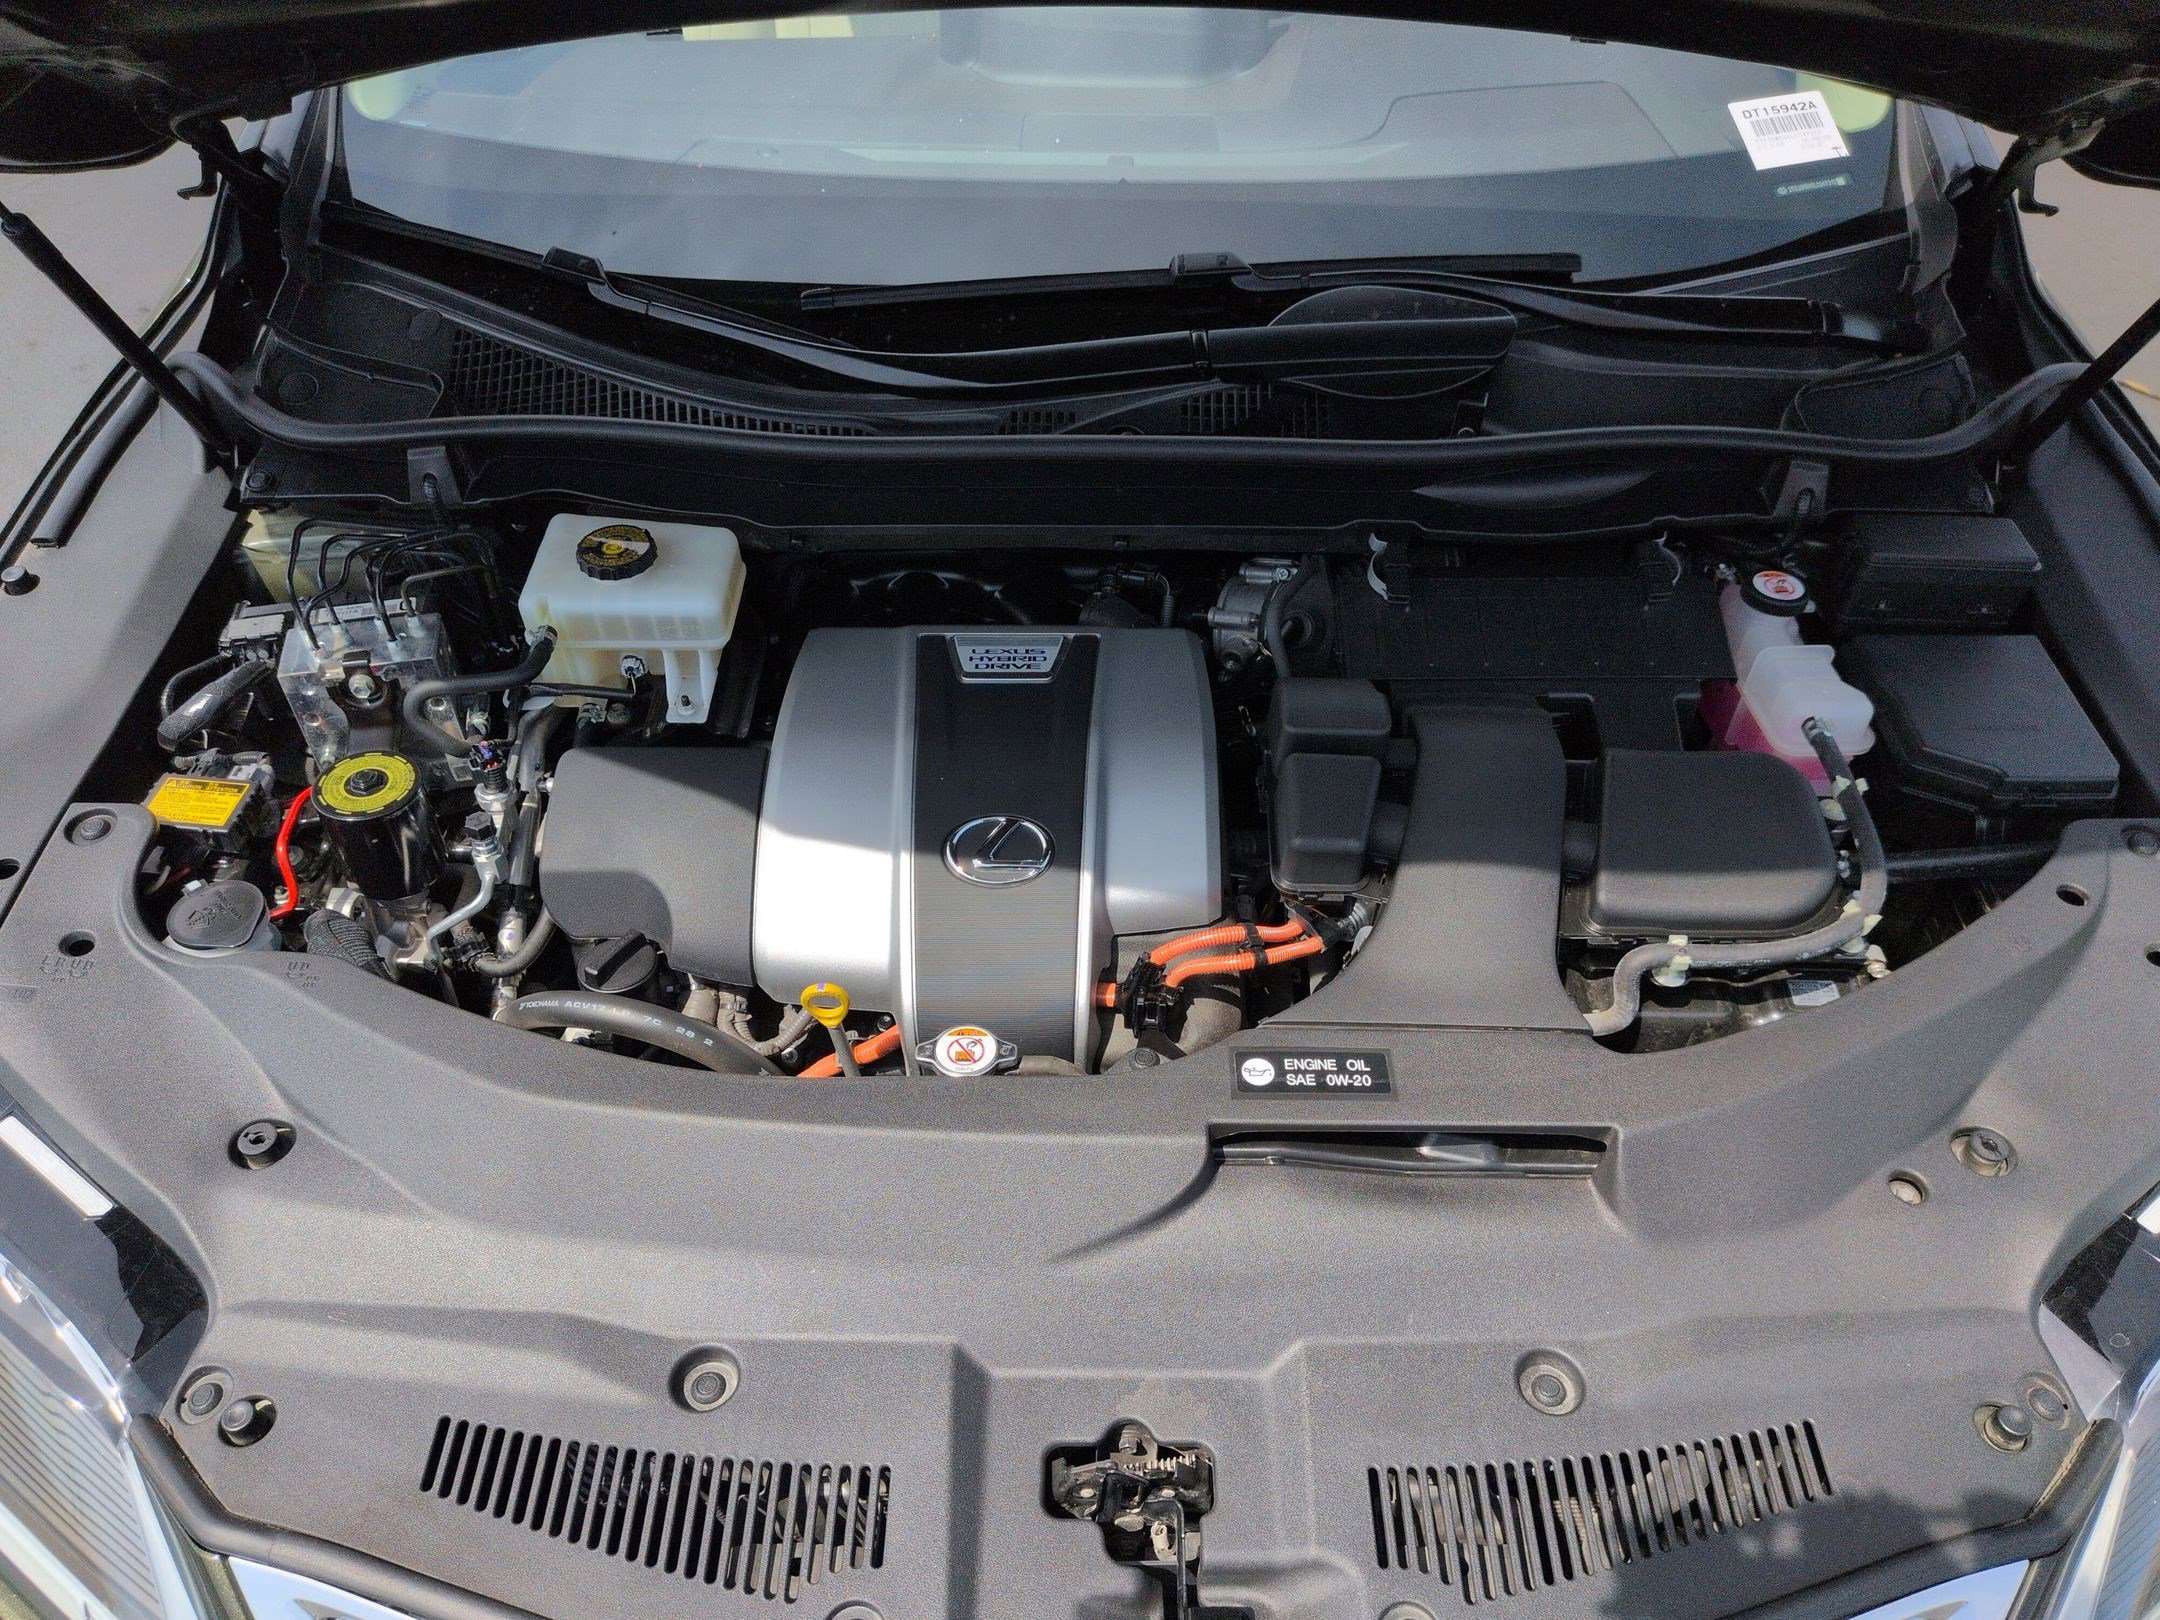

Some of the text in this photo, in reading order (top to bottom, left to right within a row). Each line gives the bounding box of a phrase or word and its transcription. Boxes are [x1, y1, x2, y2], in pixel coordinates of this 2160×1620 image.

[1741, 100, 1818, 120] DT15942A
[1283, 1058, 1371, 1072] ENGINE OIL
[1286, 1074, 1372, 1087] SAE 0W-20
